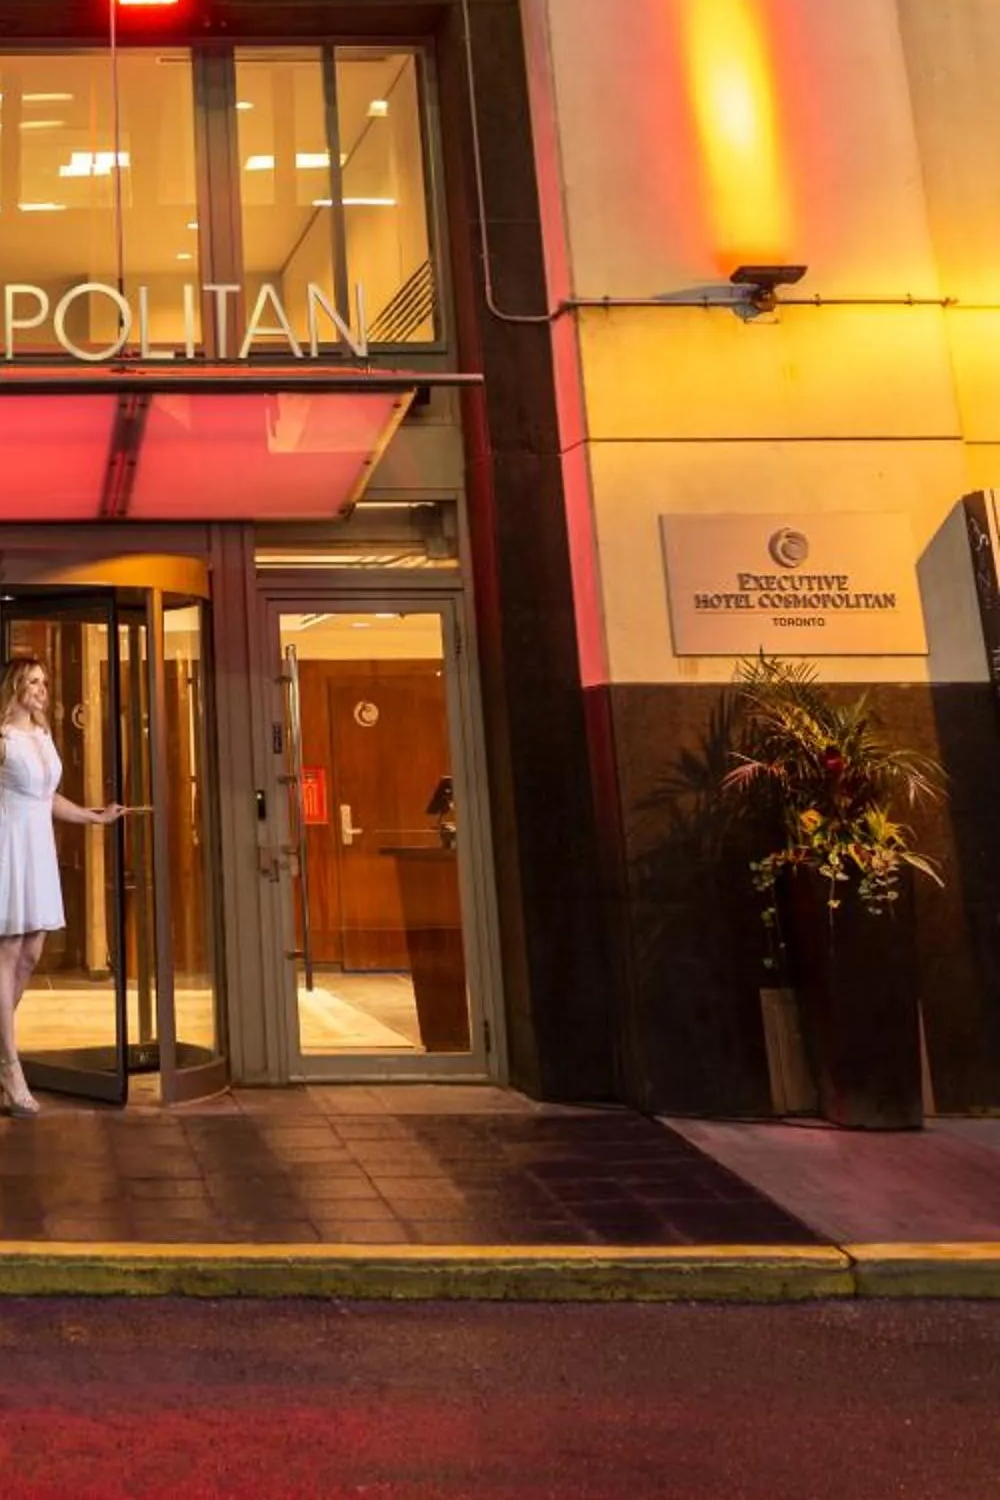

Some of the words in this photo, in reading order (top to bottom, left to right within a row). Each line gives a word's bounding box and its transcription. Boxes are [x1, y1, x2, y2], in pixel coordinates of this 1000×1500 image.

[737, 573, 849, 592] EXECUTIVE
[694, 593, 754, 609] HOTEL
[758, 593, 897, 609] COSMOPOLITAN
[773, 617, 826, 627] TORONTO
